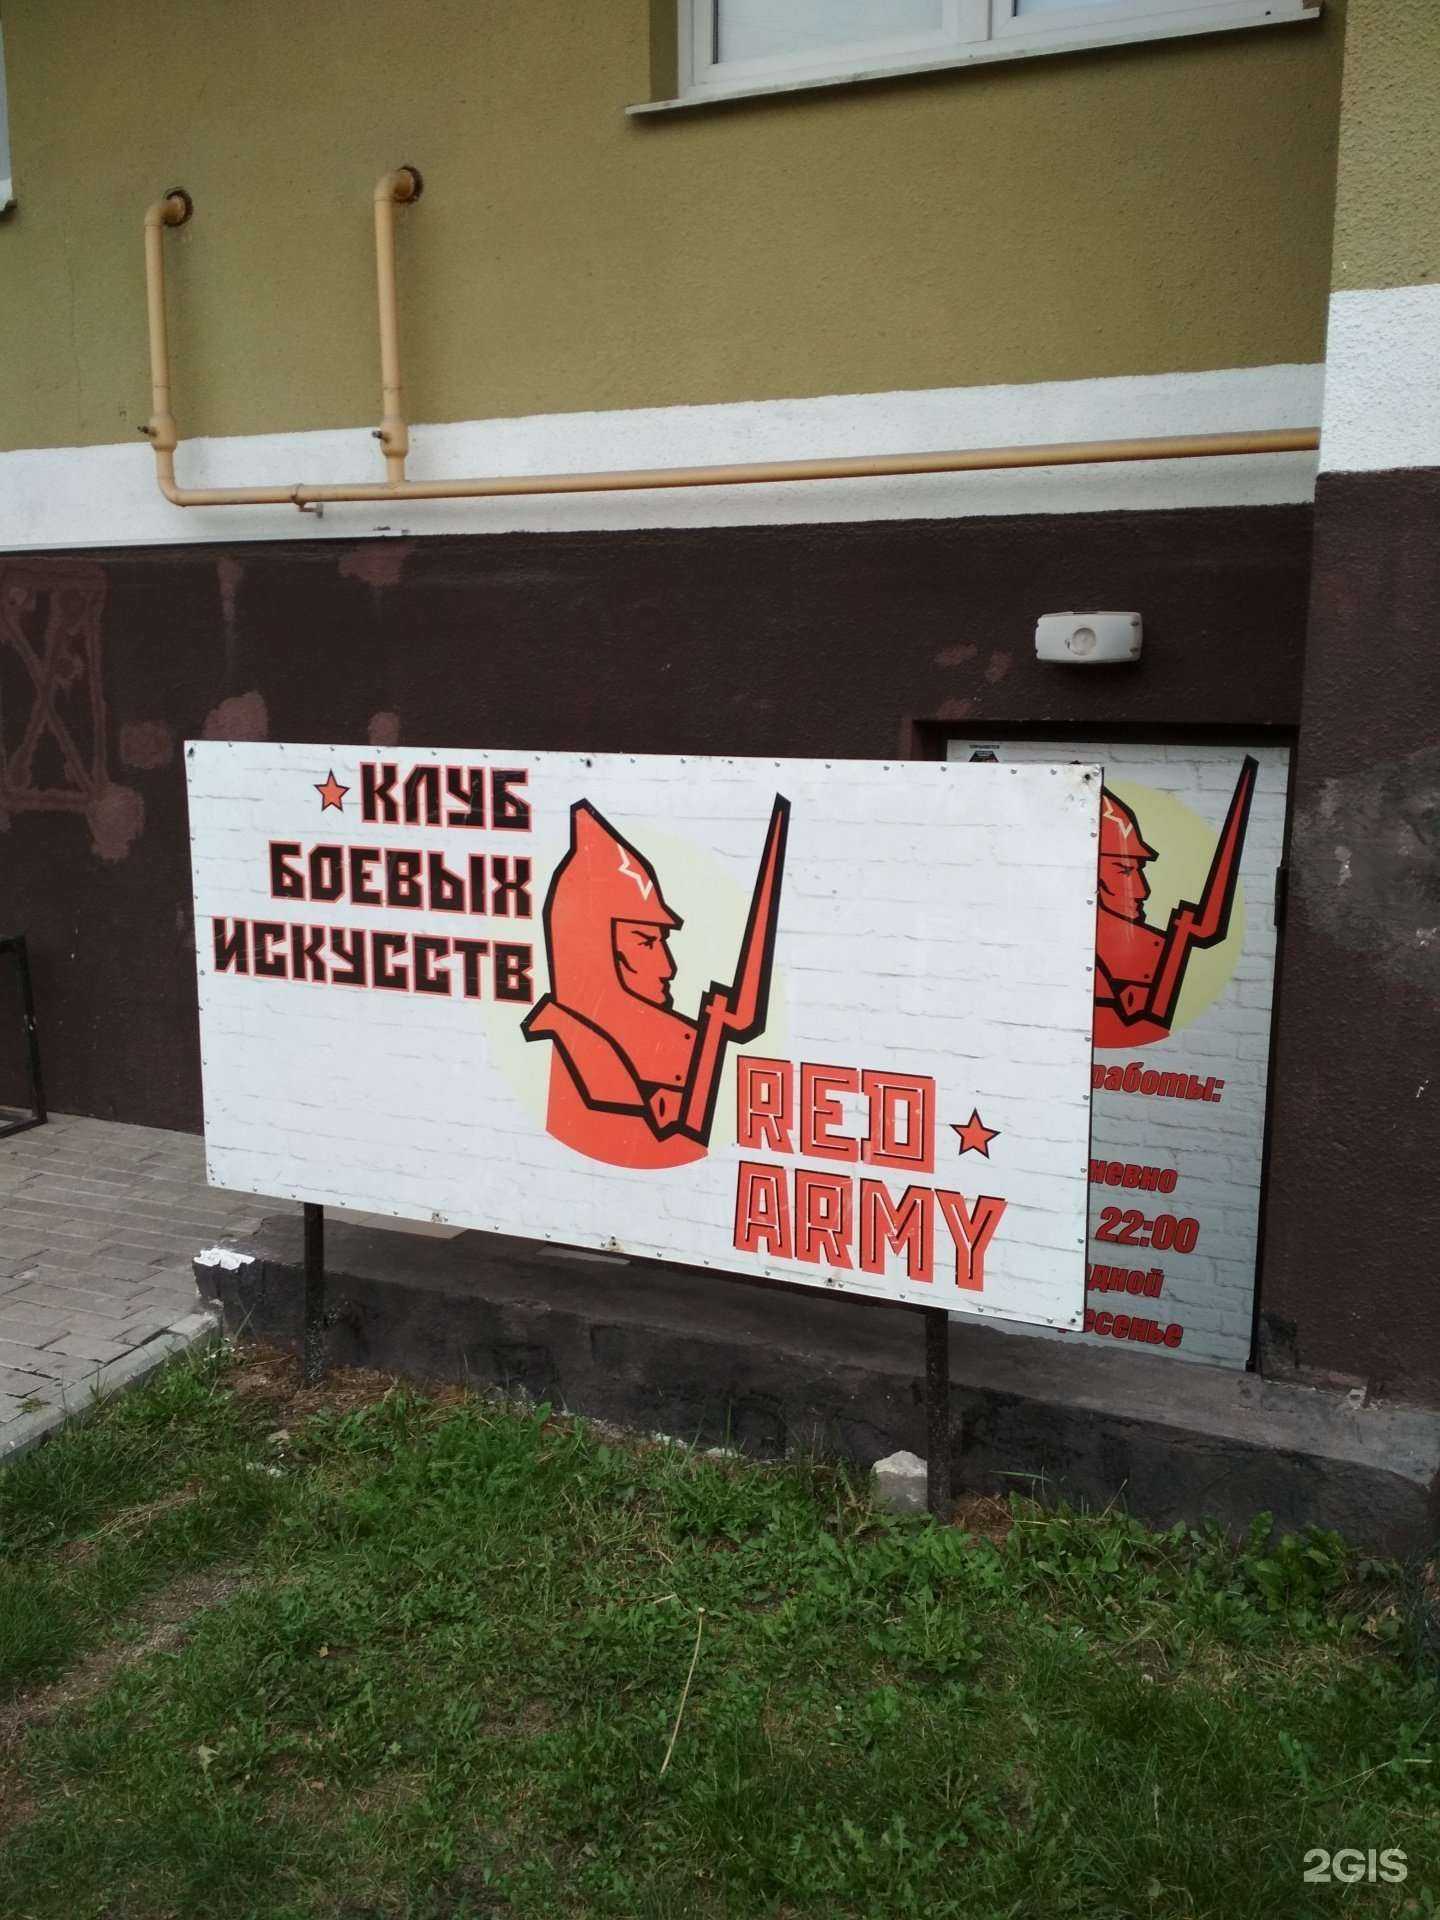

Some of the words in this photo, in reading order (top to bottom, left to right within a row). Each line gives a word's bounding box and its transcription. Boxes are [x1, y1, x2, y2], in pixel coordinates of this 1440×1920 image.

[360, 761, 532, 832] КЛУБ
[269, 840, 532, 919] БОЕВЫХ
[212, 916, 534, 1005] ИСКУССТВ
[737, 1055, 936, 1174] RED
[733, 1160, 1008, 1292] ARMY
[1095, 1206, 1200, 1253] 22:00
[1086, 1263, 1164, 1297] дной
